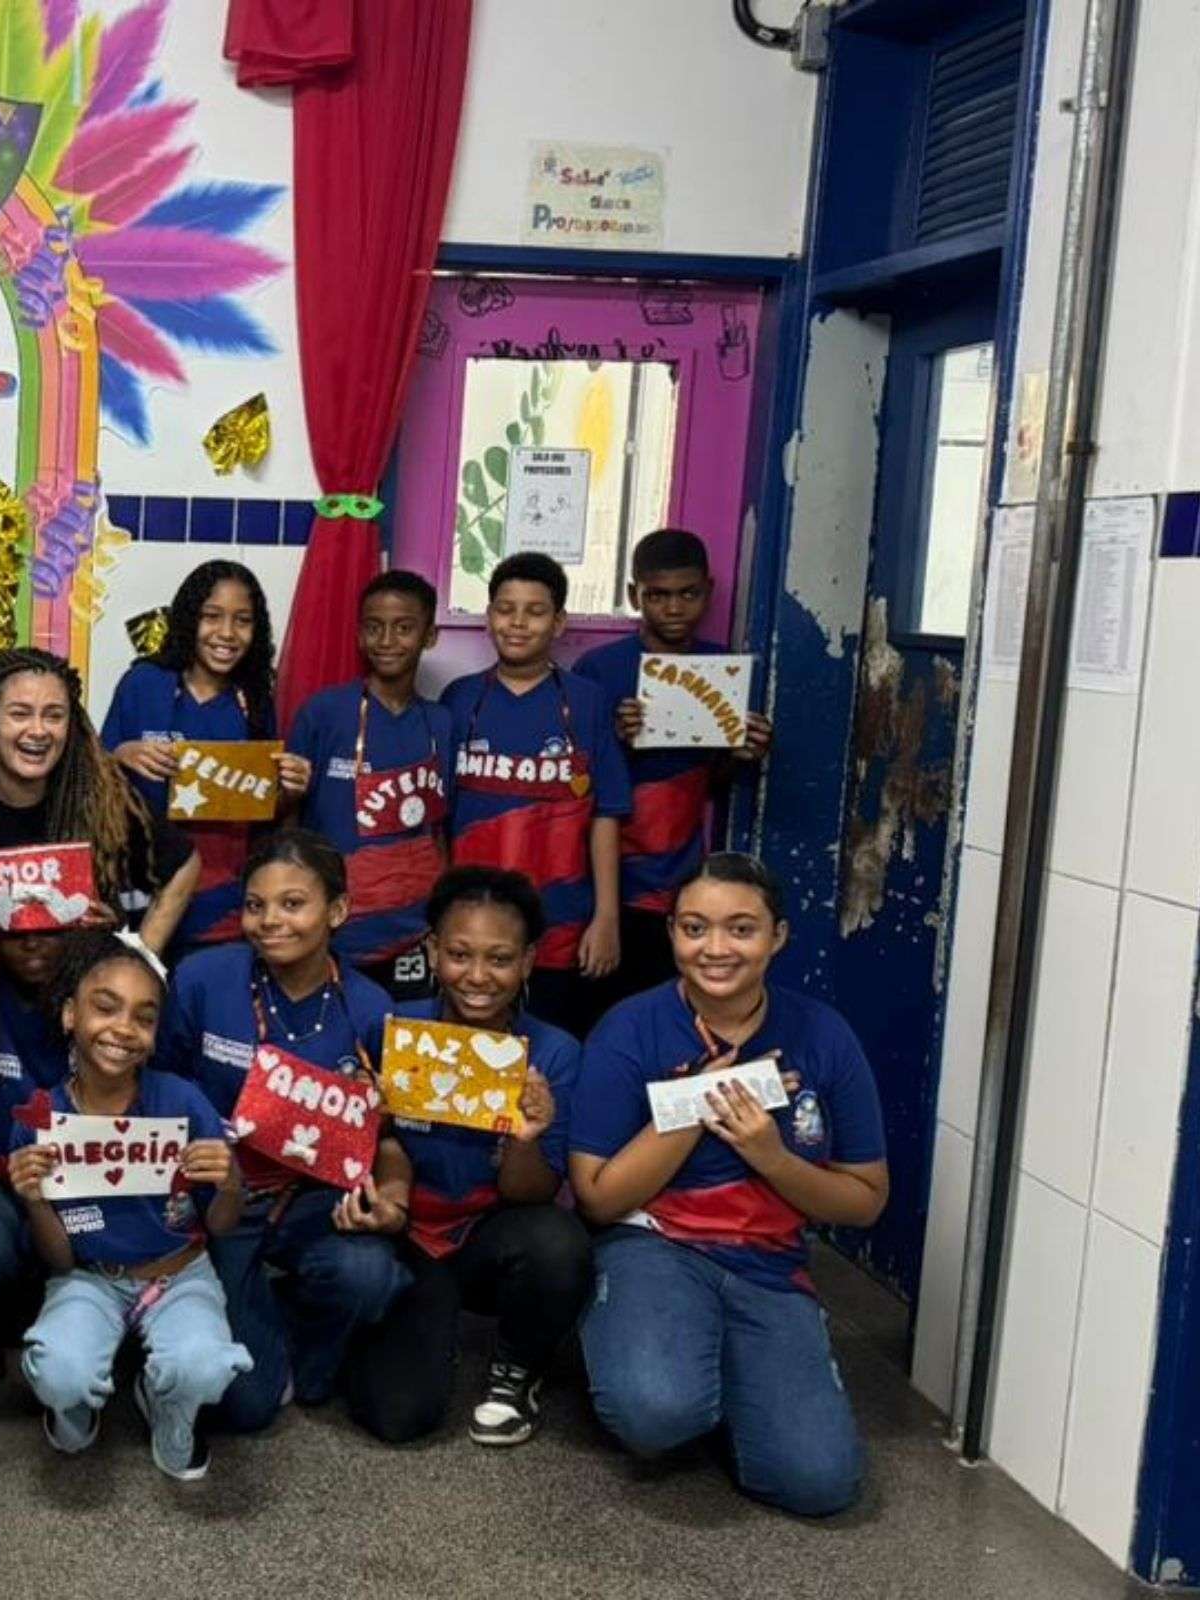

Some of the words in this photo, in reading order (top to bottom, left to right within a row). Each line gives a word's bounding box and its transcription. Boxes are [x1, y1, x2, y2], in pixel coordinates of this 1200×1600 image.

[394, 954, 426, 981] 23
[395, 1028, 462, 1064] PAZ
[266, 1063, 368, 1129] AMOR
